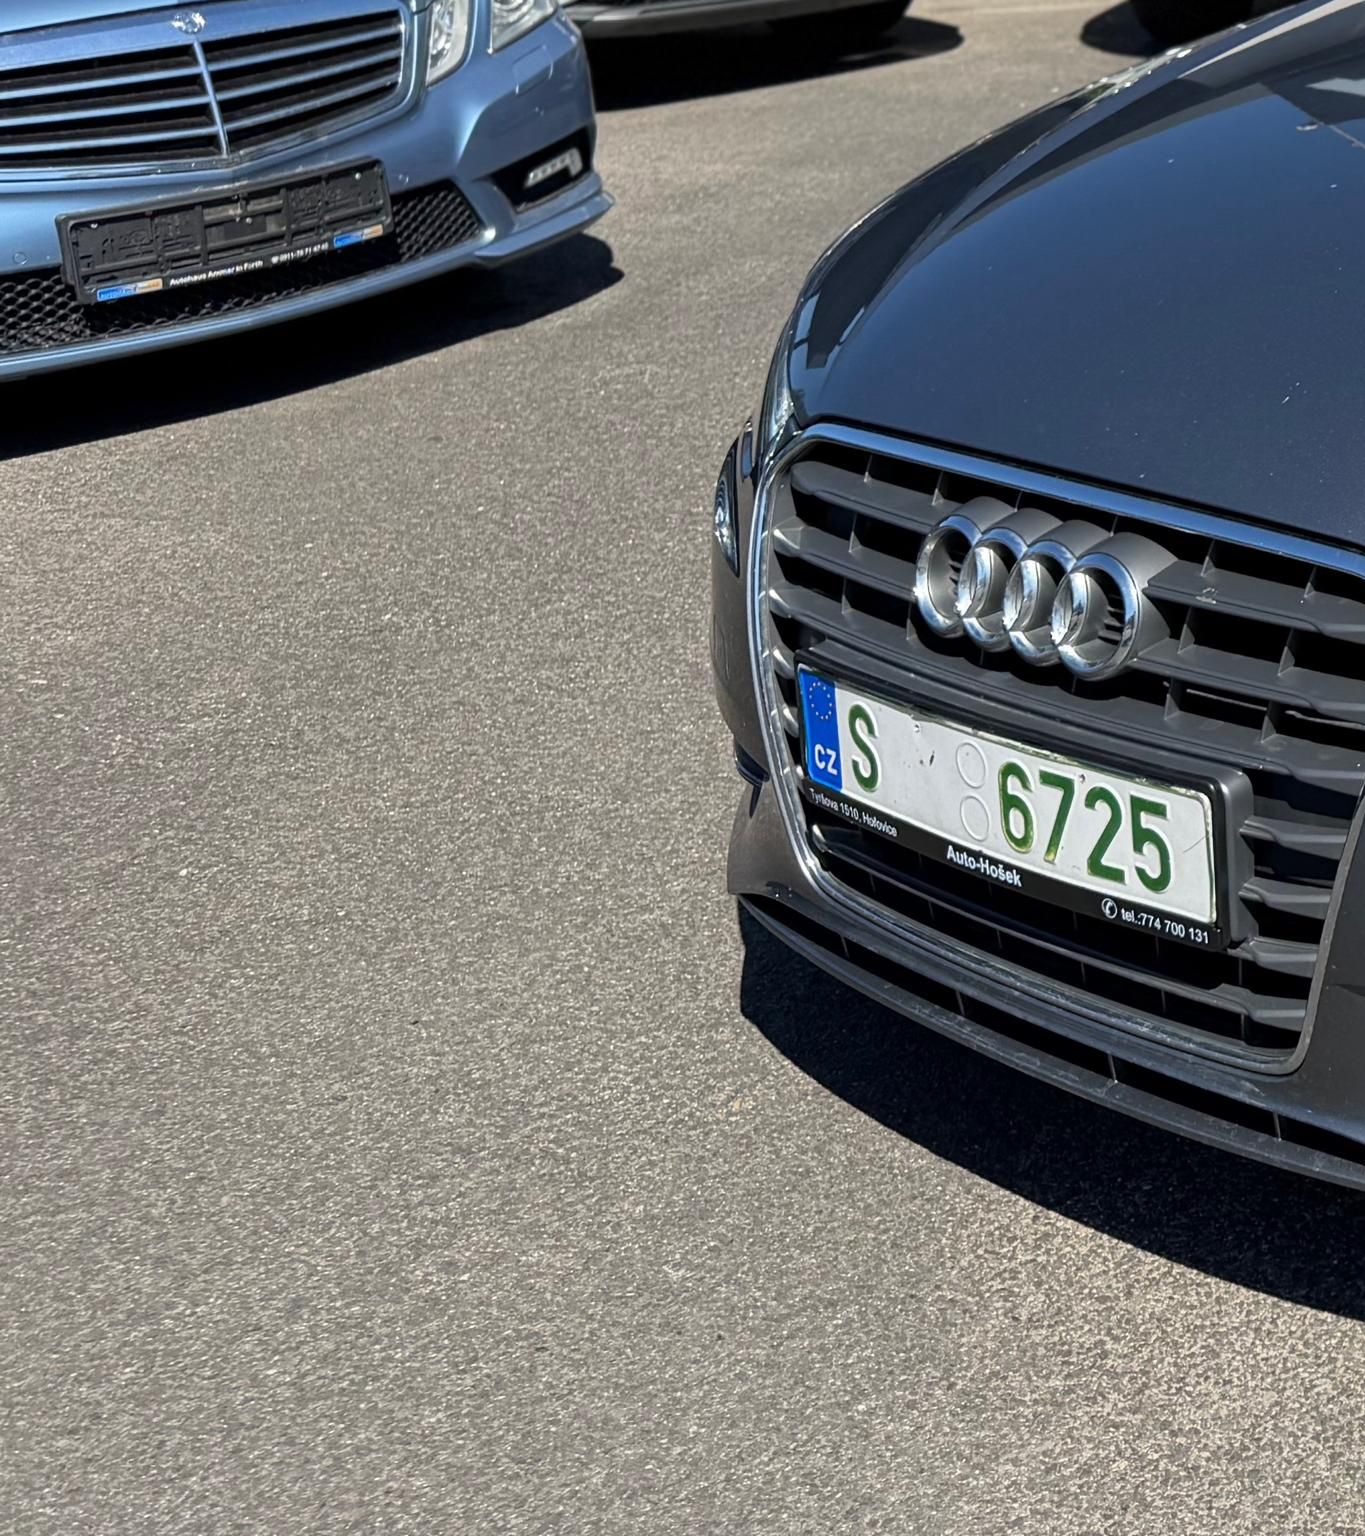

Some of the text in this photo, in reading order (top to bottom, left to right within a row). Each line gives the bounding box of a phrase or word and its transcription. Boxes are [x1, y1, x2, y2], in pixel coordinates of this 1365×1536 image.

[814, 744, 839, 777] CZ
[847, 701, 1173, 893] S 6725
[946, 844, 1023, 887] Auto-Hošek
[1164, 919, 1186, 939] 700
[1188, 925, 1209, 945] 131
